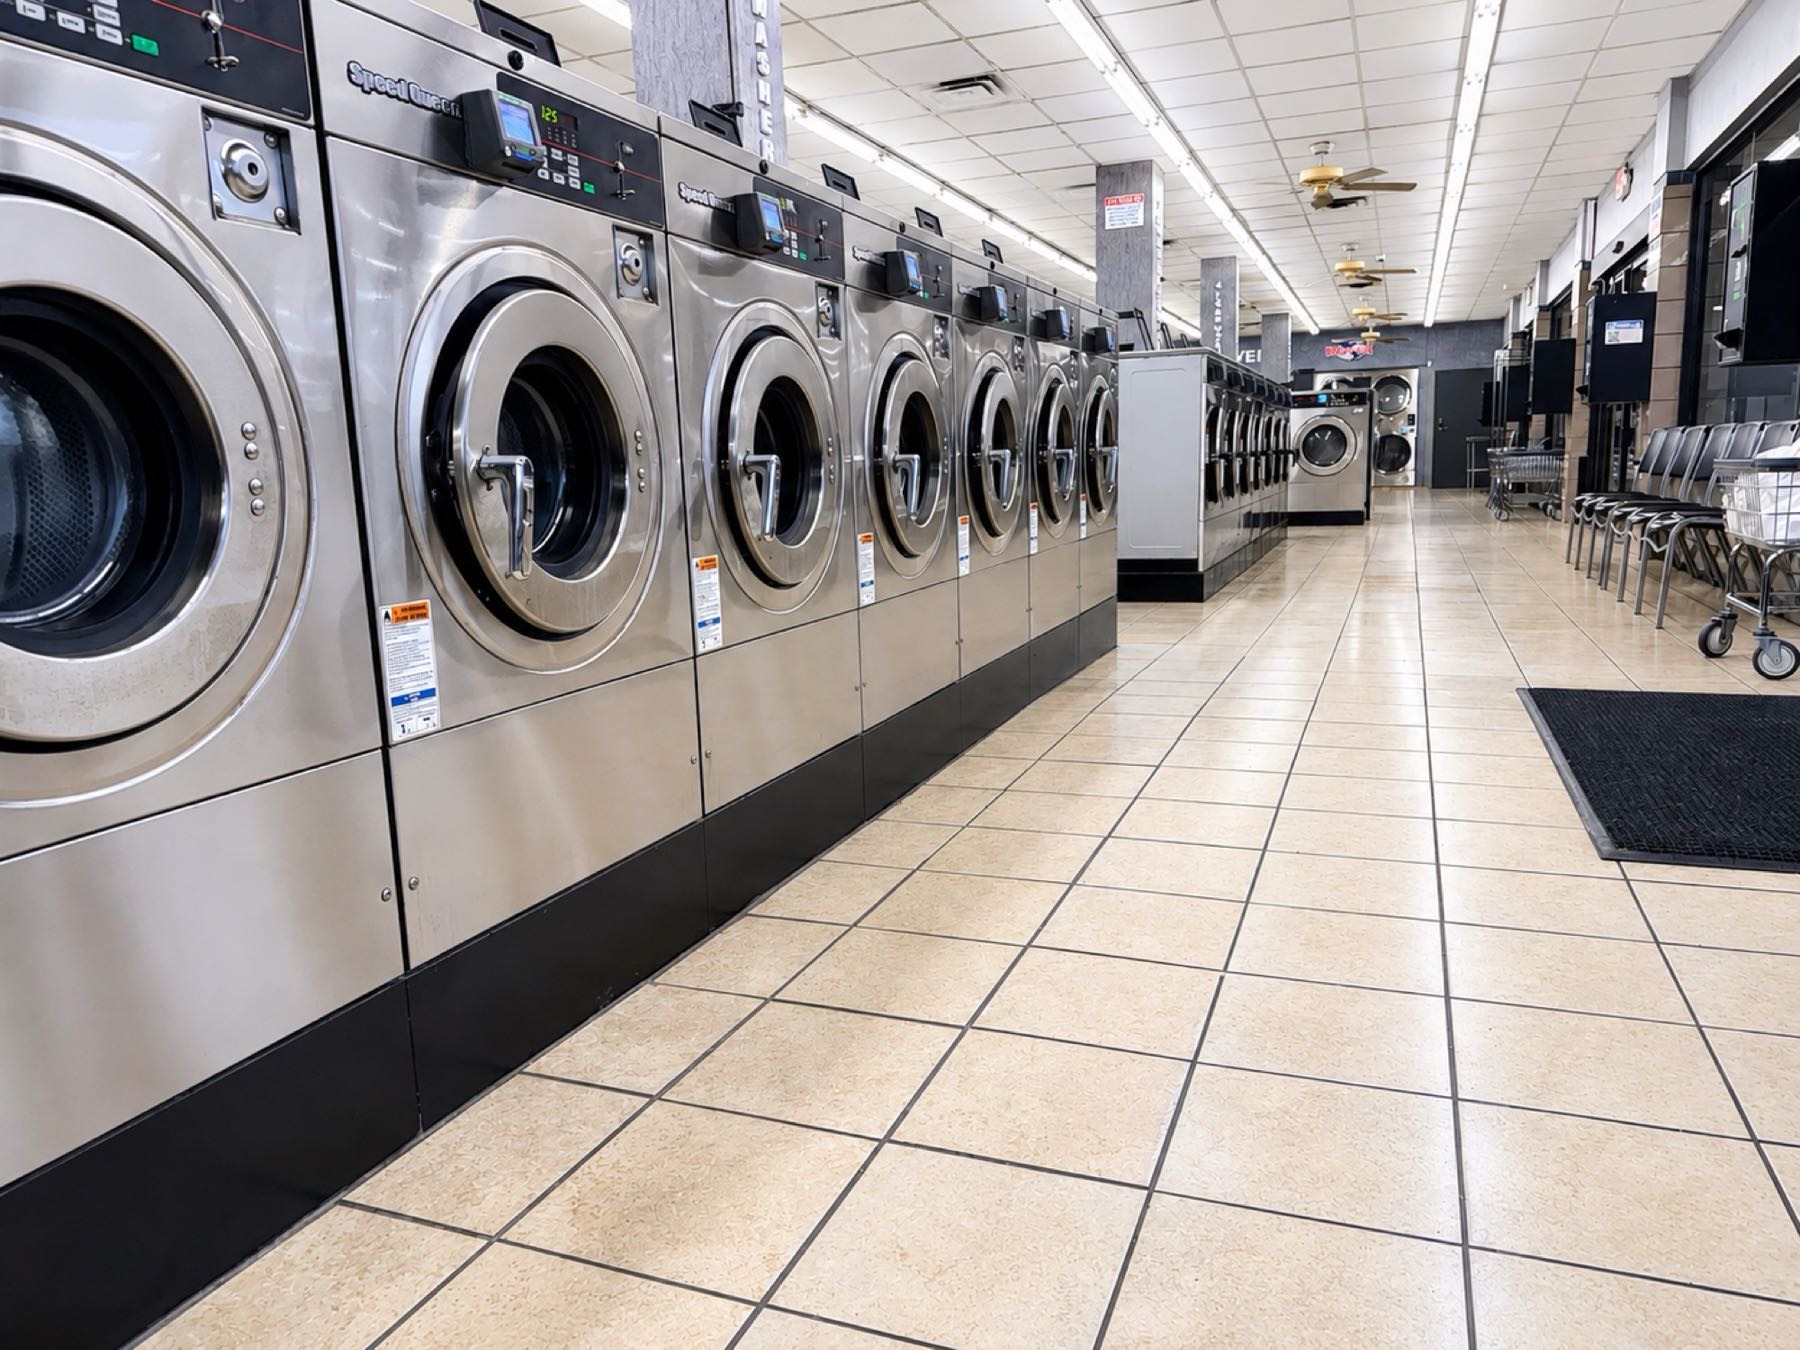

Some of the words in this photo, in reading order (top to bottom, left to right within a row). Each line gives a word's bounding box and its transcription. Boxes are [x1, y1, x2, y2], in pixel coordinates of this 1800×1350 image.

[347, 60, 410, 103] Speed
[408, 82, 462, 119] Queen
[541, 105, 558, 123] 125
